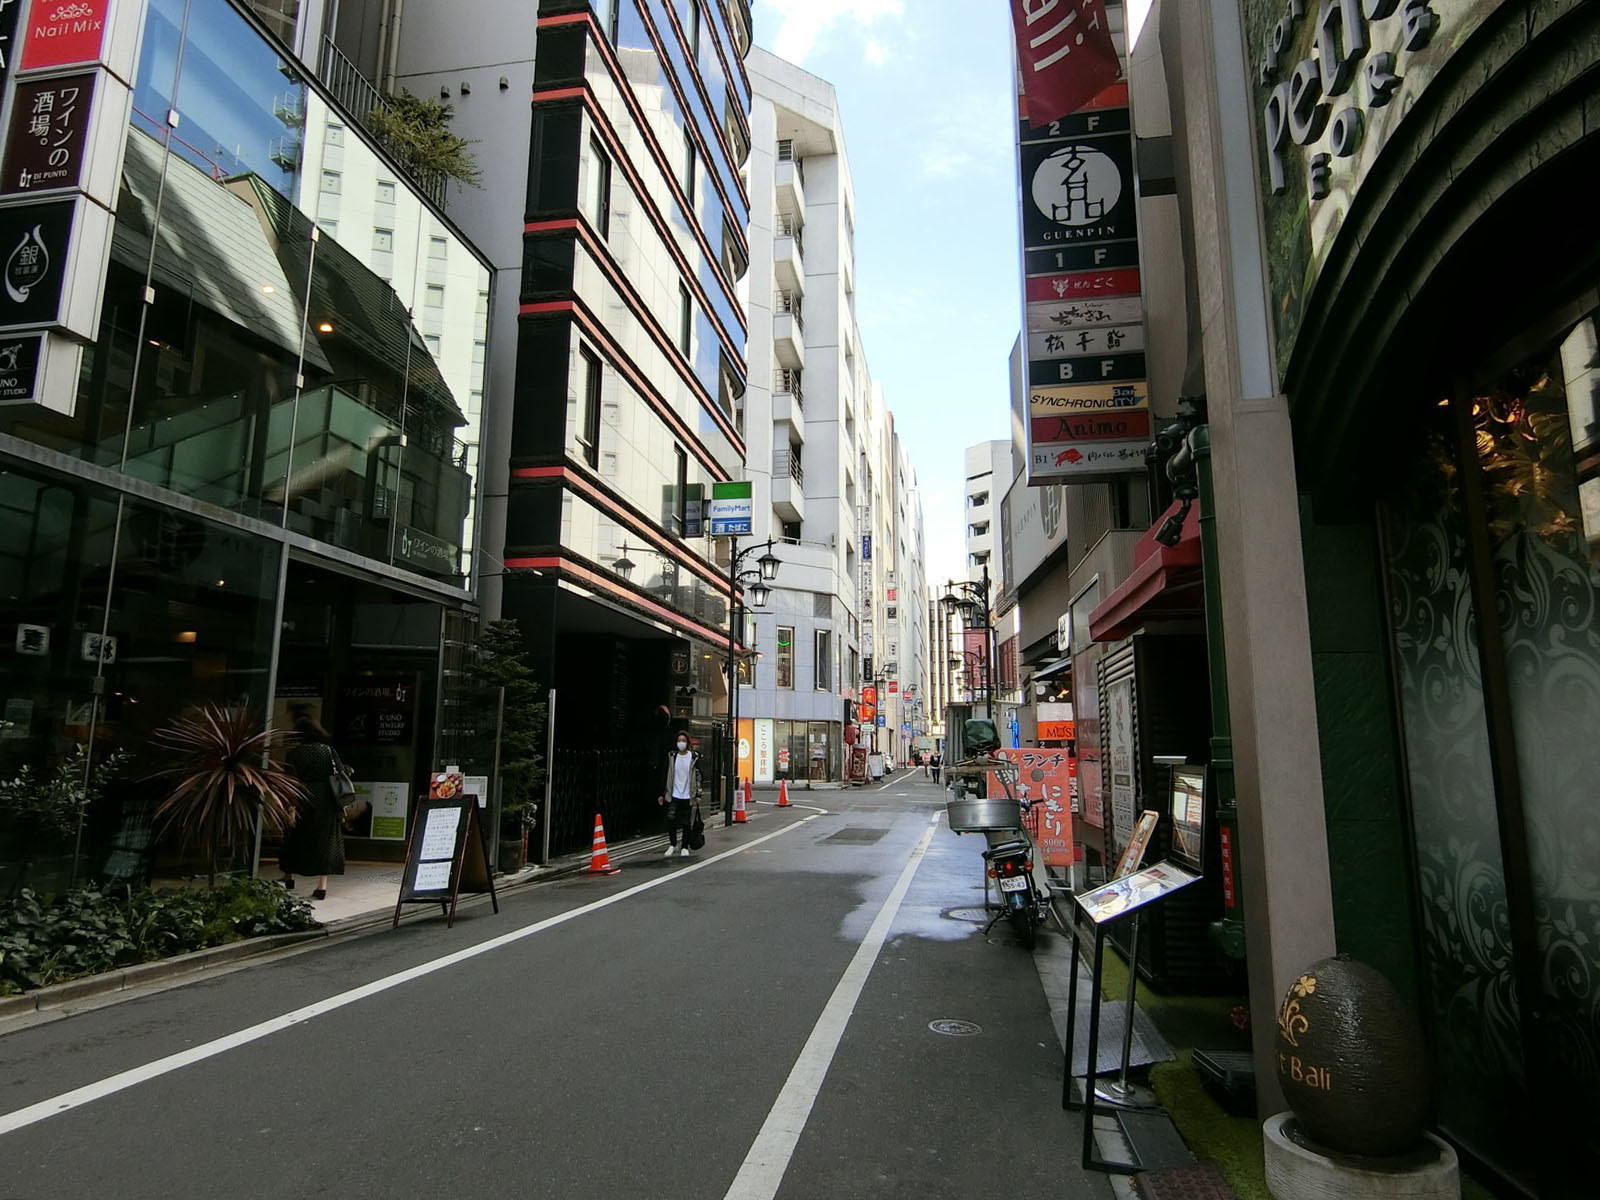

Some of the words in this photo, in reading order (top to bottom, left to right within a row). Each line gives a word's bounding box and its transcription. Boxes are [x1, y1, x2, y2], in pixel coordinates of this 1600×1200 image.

[35, 23, 69, 38] Nail
[73, 20, 101, 33] Mix
[49, 88, 79, 167] ワインの
[1048, 121, 1060, 136] 2
[1087, 116, 1100, 131] F
[43, 170, 68, 179] PUNTO
[1043, 225, 1116, 240] GUENPIN
[1055, 252, 1064, 268] 1
[1094, 248, 1107, 265] F
[1059, 363, 1073, 380] B
[1101, 360, 1114, 377] F
[1030, 395, 1135, 408] SYNCHRONICITY
[1053, 417, 1128, 440] Animo
[1035, 455, 1047, 464] B1
[713, 505, 751, 513] FamilyMart
[728, 523, 749, 532] たばこ
[1022, 753, 1064, 768] ランチ
[1291, 1056, 1331, 1090] Bali
